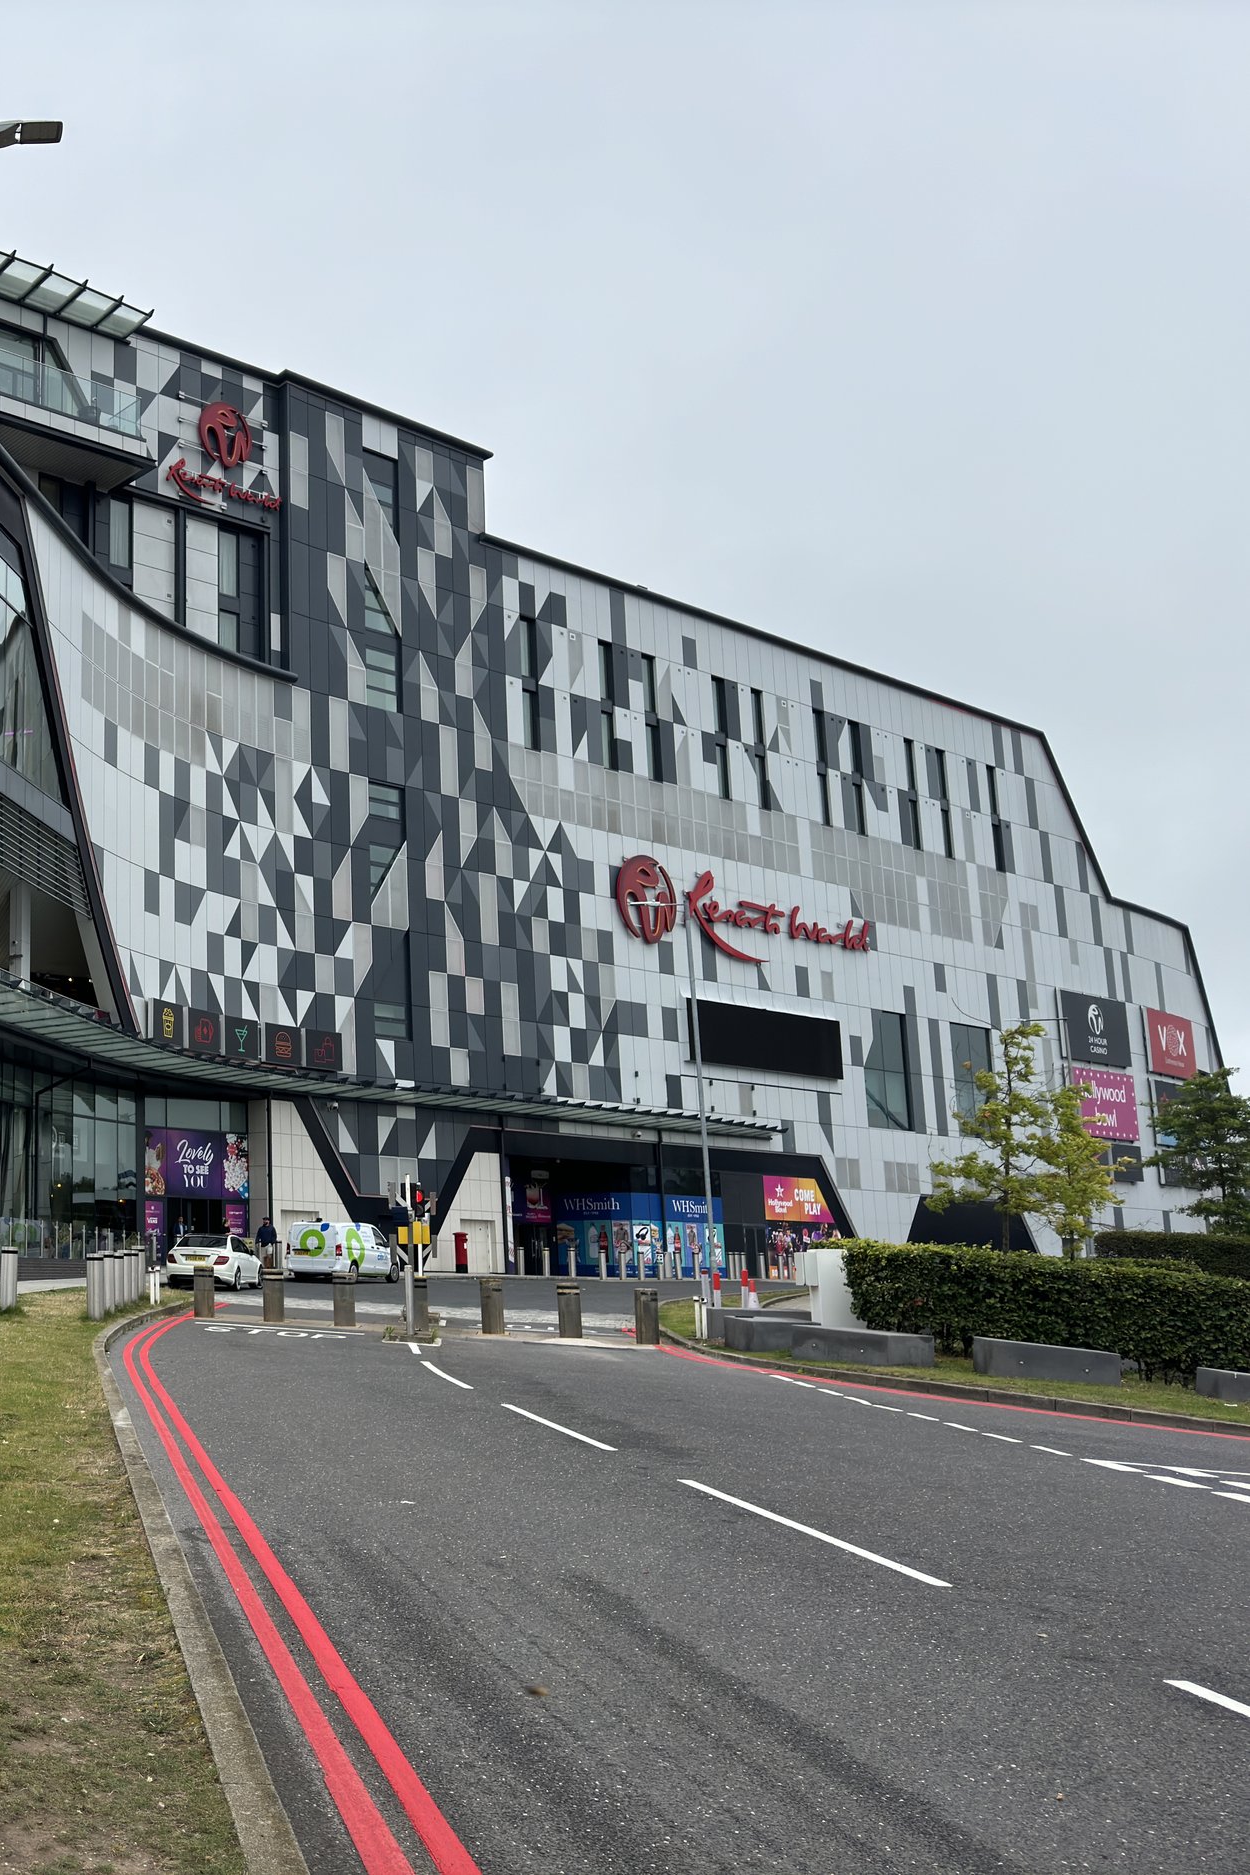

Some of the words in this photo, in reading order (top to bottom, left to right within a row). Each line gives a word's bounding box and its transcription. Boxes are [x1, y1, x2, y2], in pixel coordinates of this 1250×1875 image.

[229, 481, 282, 511] World
[684, 869, 785, 963] Resorts
[789, 905, 872, 953] World
[1088, 1036, 1094, 1044] 24
[1093, 1036, 1108, 1046] HOUR
[1157, 1024, 1187, 1057] VOX
[1090, 1045, 1108, 1056] CASINO
[174, 1139, 214, 1168] Lovely
[183, 1164, 194, 1175] TO
[195, 1164, 209, 1175] SEE
[183, 1174, 208, 1189] YOU
[794, 1188, 815, 1202] COME
[563, 1197, 620, 1211] WHSmith
[672, 1199, 708, 1214] WHSmit
[768, 1198, 793, 1208] Hollywood
[804, 1202, 821, 1216] PLAY
[203, 1325, 347, 1340] STOP
